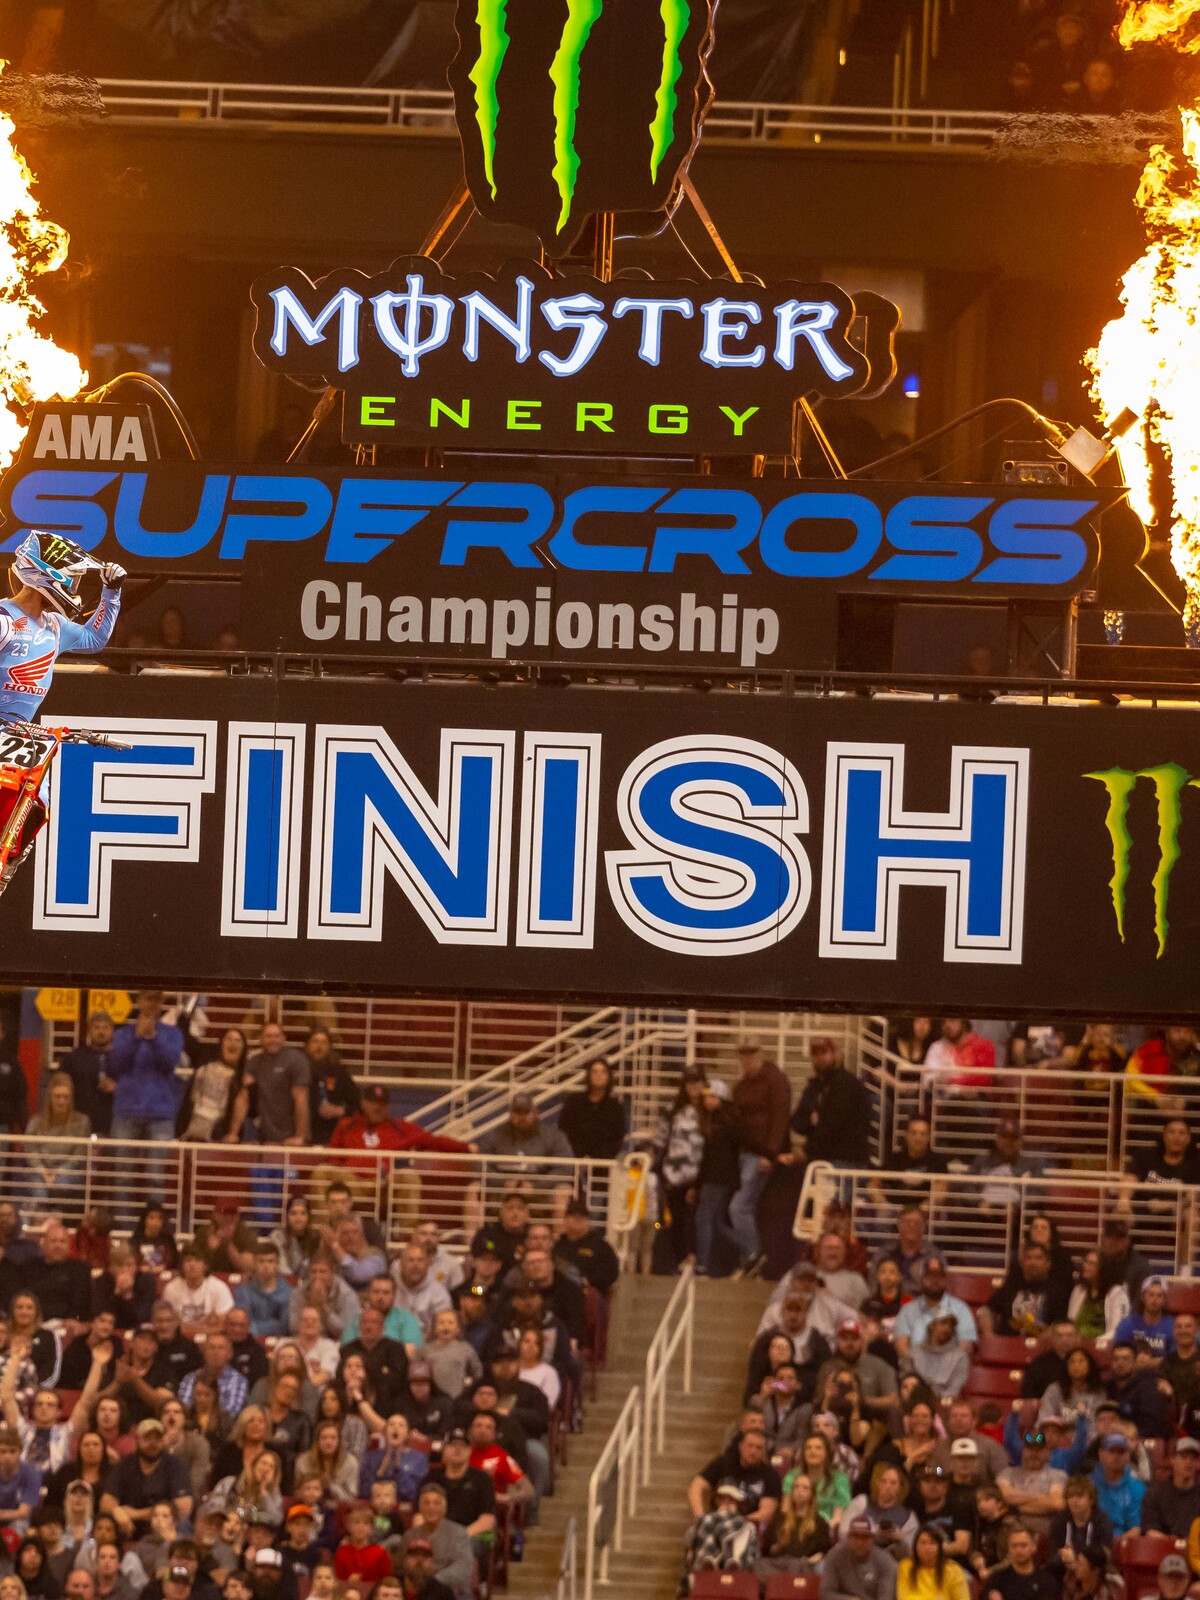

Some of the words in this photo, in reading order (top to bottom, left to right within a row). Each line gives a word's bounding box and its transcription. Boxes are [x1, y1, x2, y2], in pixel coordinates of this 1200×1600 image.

[268, 274, 854, 380] MONSTER
[33, 414, 147, 462] AMA
[360, 396, 760, 436] ENERGY
[11, 642, 30, 657] 23
[300, 579, 780, 668] Championship
[33, 715, 1030, 965] FINISH
